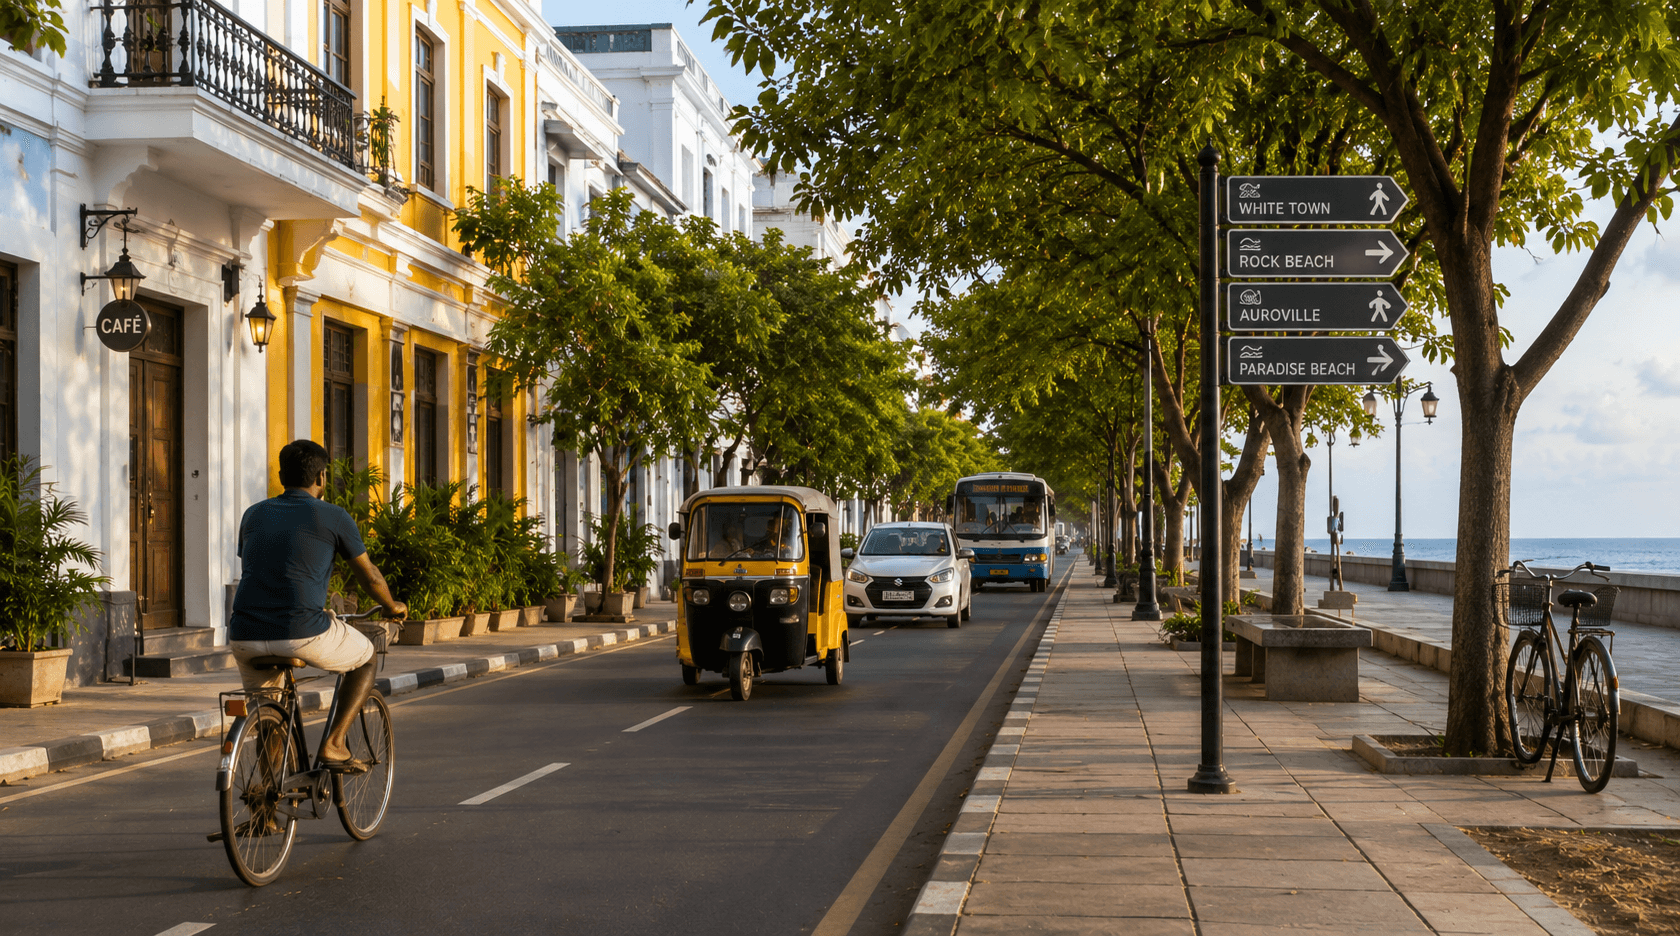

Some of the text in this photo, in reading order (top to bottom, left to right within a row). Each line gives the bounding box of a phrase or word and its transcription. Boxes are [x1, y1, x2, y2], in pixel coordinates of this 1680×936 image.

[1239, 202, 1330, 214] WHITE TOWN
[1240, 255, 1333, 267] ROCK BEACH
[1240, 309, 1320, 321] AUROVILLE
[101, 314, 142, 334] CAFÉ
[1240, 363, 1355, 375] PARADISE BEACH
